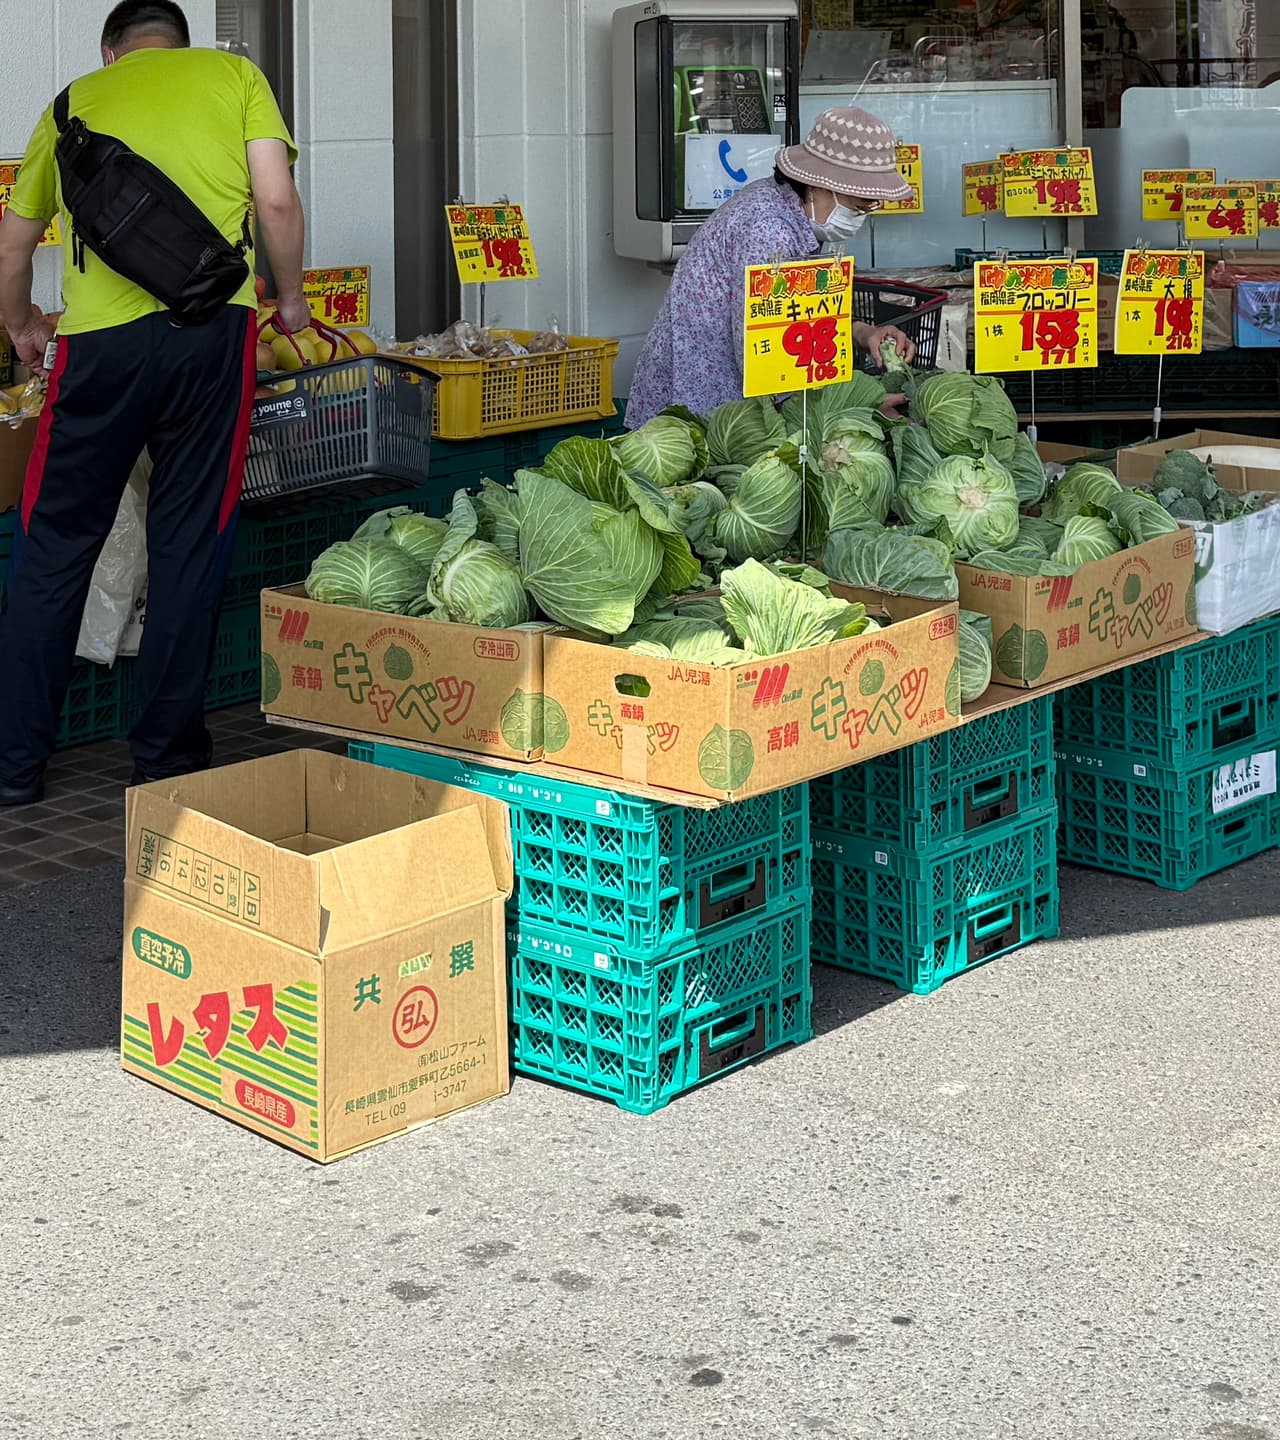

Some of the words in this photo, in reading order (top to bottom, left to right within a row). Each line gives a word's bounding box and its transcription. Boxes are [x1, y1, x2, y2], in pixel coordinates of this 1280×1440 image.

[713, 189, 742, 200] 公衆
[1035, 179, 1082, 205] 198
[482, 239, 523, 267] 198
[322, 283, 366, 296] シナノゴールド
[1124, 279, 1153, 293] 長崎県産
[1163, 278, 1192, 300] 大根
[750, 300, 783, 318] 宮崎県産
[786, 295, 844, 321] キャベツ
[981, 291, 1017, 307] 福岡県産
[1017, 290, 1091, 312] ブロッコリー
[1124, 309, 1141, 322] 1本
[1154, 298, 1193, 337] 198
[782, 317, 839, 367] 98
[985, 325, 1004, 338] 1株
[1020, 311, 1081, 351] 158
[1166, 334, 1193, 351] 214
[1040, 349, 1076, 365] 171
[258, 399, 293, 417] youme
[970, 572, 1012, 592] JA児湯
[1056, 625, 1080, 651] 高鍋
[1088, 582, 1174, 649] キャベツ
[291, 664, 323, 692] 高鍋
[333, 642, 476, 733] キャベツ
[667, 665, 711, 687] JA児湯
[620, 702, 645, 722] 高鍋
[767, 721, 800, 754] 高鍋
[810, 666, 930, 750] キャベツ
[918, 706, 945, 729] JA児湯
[463, 726, 500, 746] JA児湯
[159, 851, 172, 873] 16
[177, 858, 190, 880] 14
[195, 865, 208, 888] 12
[212, 873, 225, 896] 10
[247, 877, 258, 893] A
[247, 901, 257, 917] B
[139, 932, 186, 975] 真空予冷
[353, 973, 382, 1012] 共
[146, 982, 290, 1067] レタス
[401, 1000, 431, 1035] 弘
[243, 1088, 288, 1124] 長崎県産
